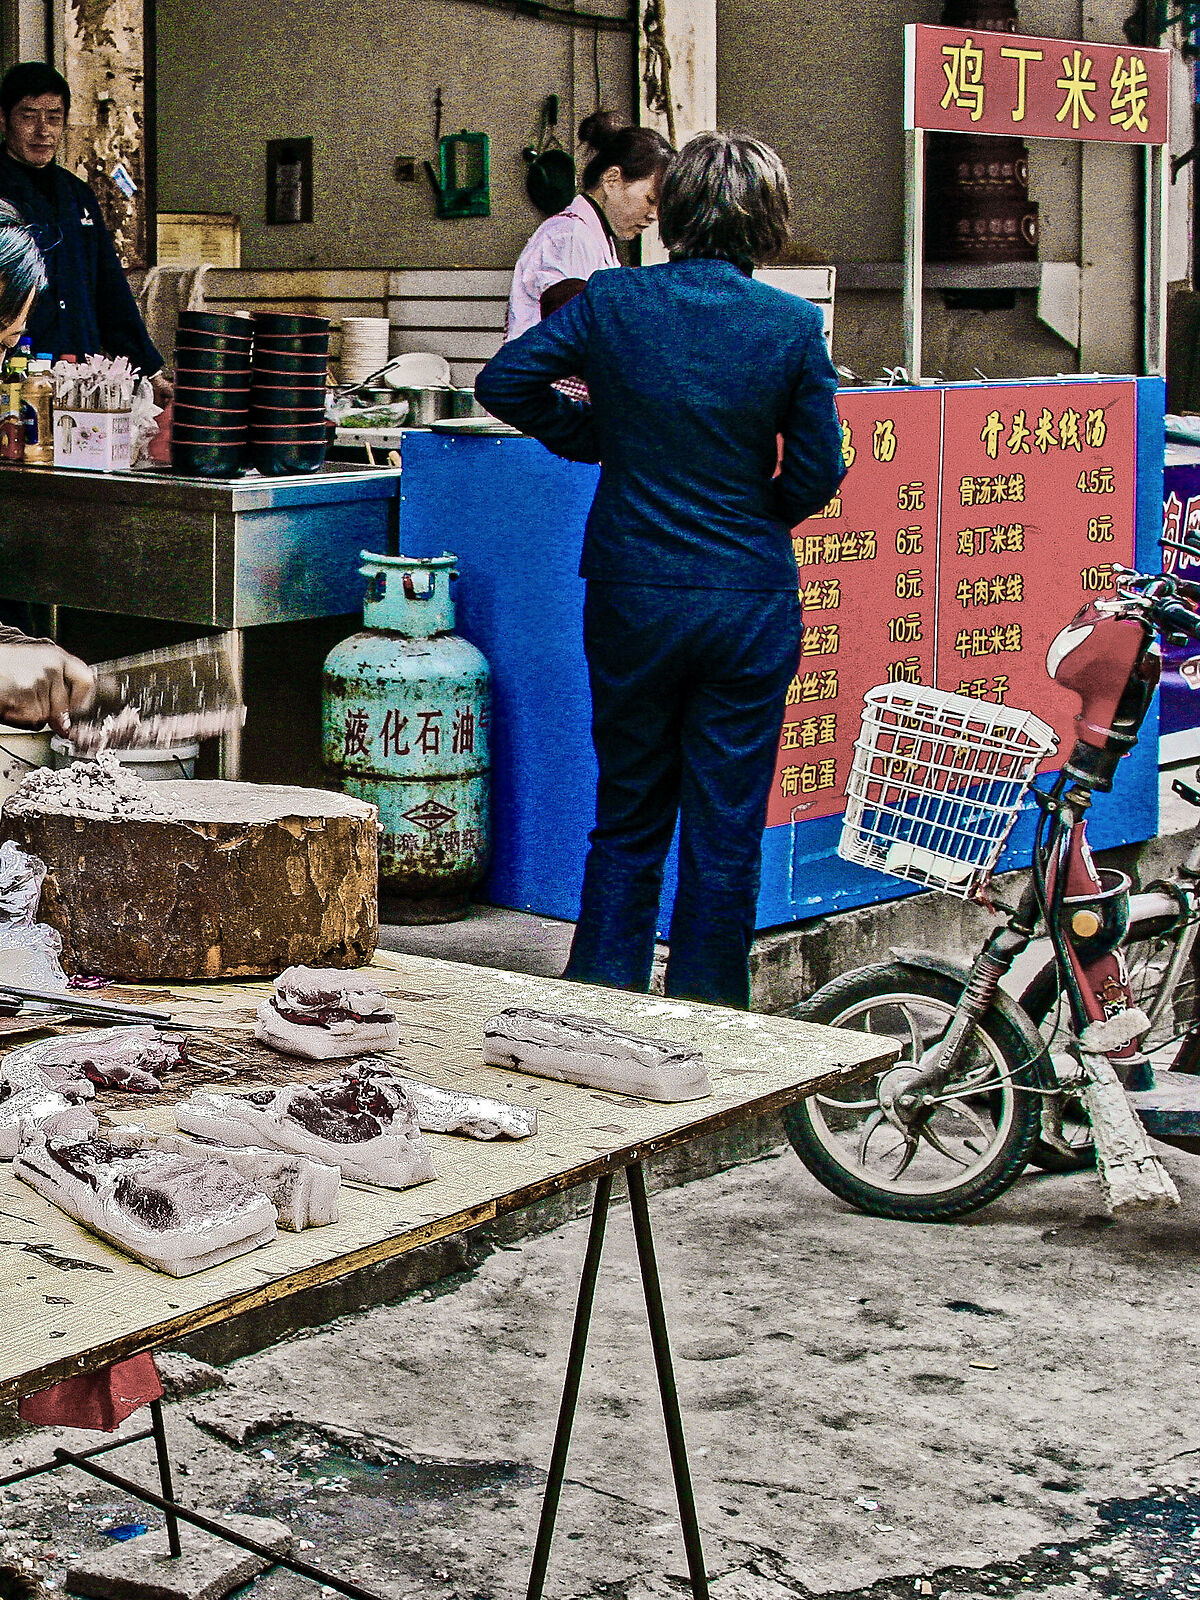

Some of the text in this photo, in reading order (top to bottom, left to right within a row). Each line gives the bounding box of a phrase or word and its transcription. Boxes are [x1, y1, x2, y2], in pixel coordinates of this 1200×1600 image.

[940, 38, 1149, 133] 鸡丁米线
[980, 407, 1107, 460] 骨头米线汤
[897, 481, 925, 511] 5元
[959, 467, 1115, 506] 骨汤米线 4.5元
[896, 525, 923, 555] 6元
[957, 515, 1114, 557] 鸡丁米线 8元
[798, 569, 923, 611] 丝汤 8元
[956, 563, 1114, 608] 牛肉米线 10元
[801, 613, 922, 657] 丝汤 10元
[955, 623, 1023, 659] 牛肚米线
[887, 657, 921, 684] 10元
[781, 713, 837, 750] 五香蛋
[780, 758, 836, 797] 荷包蛋
